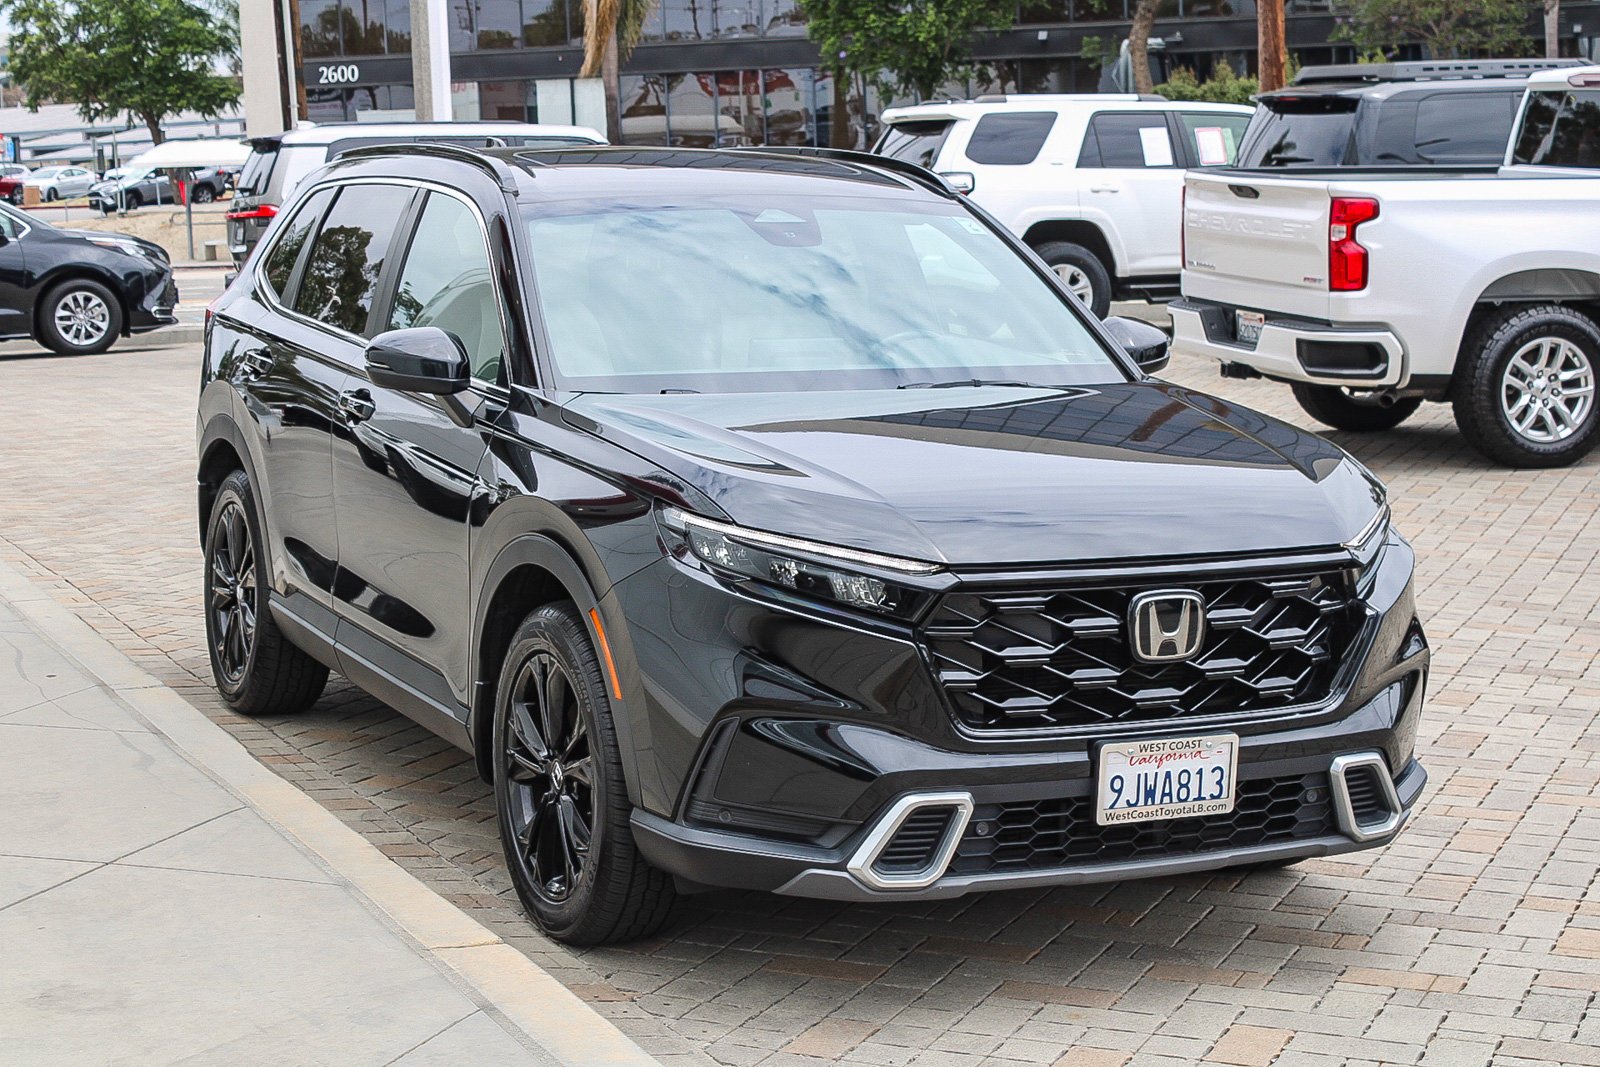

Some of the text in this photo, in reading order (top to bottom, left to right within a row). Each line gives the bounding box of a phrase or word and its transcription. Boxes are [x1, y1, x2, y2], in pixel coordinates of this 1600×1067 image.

[318, 64, 359, 84] 2600
[1138, 739, 1203, 754] WEST COAST
[1128, 750, 1210, 769] California
[1108, 765, 1225, 810] 9JWA813
[1105, 802, 1227, 822] WestCoastToyotaLB.com
